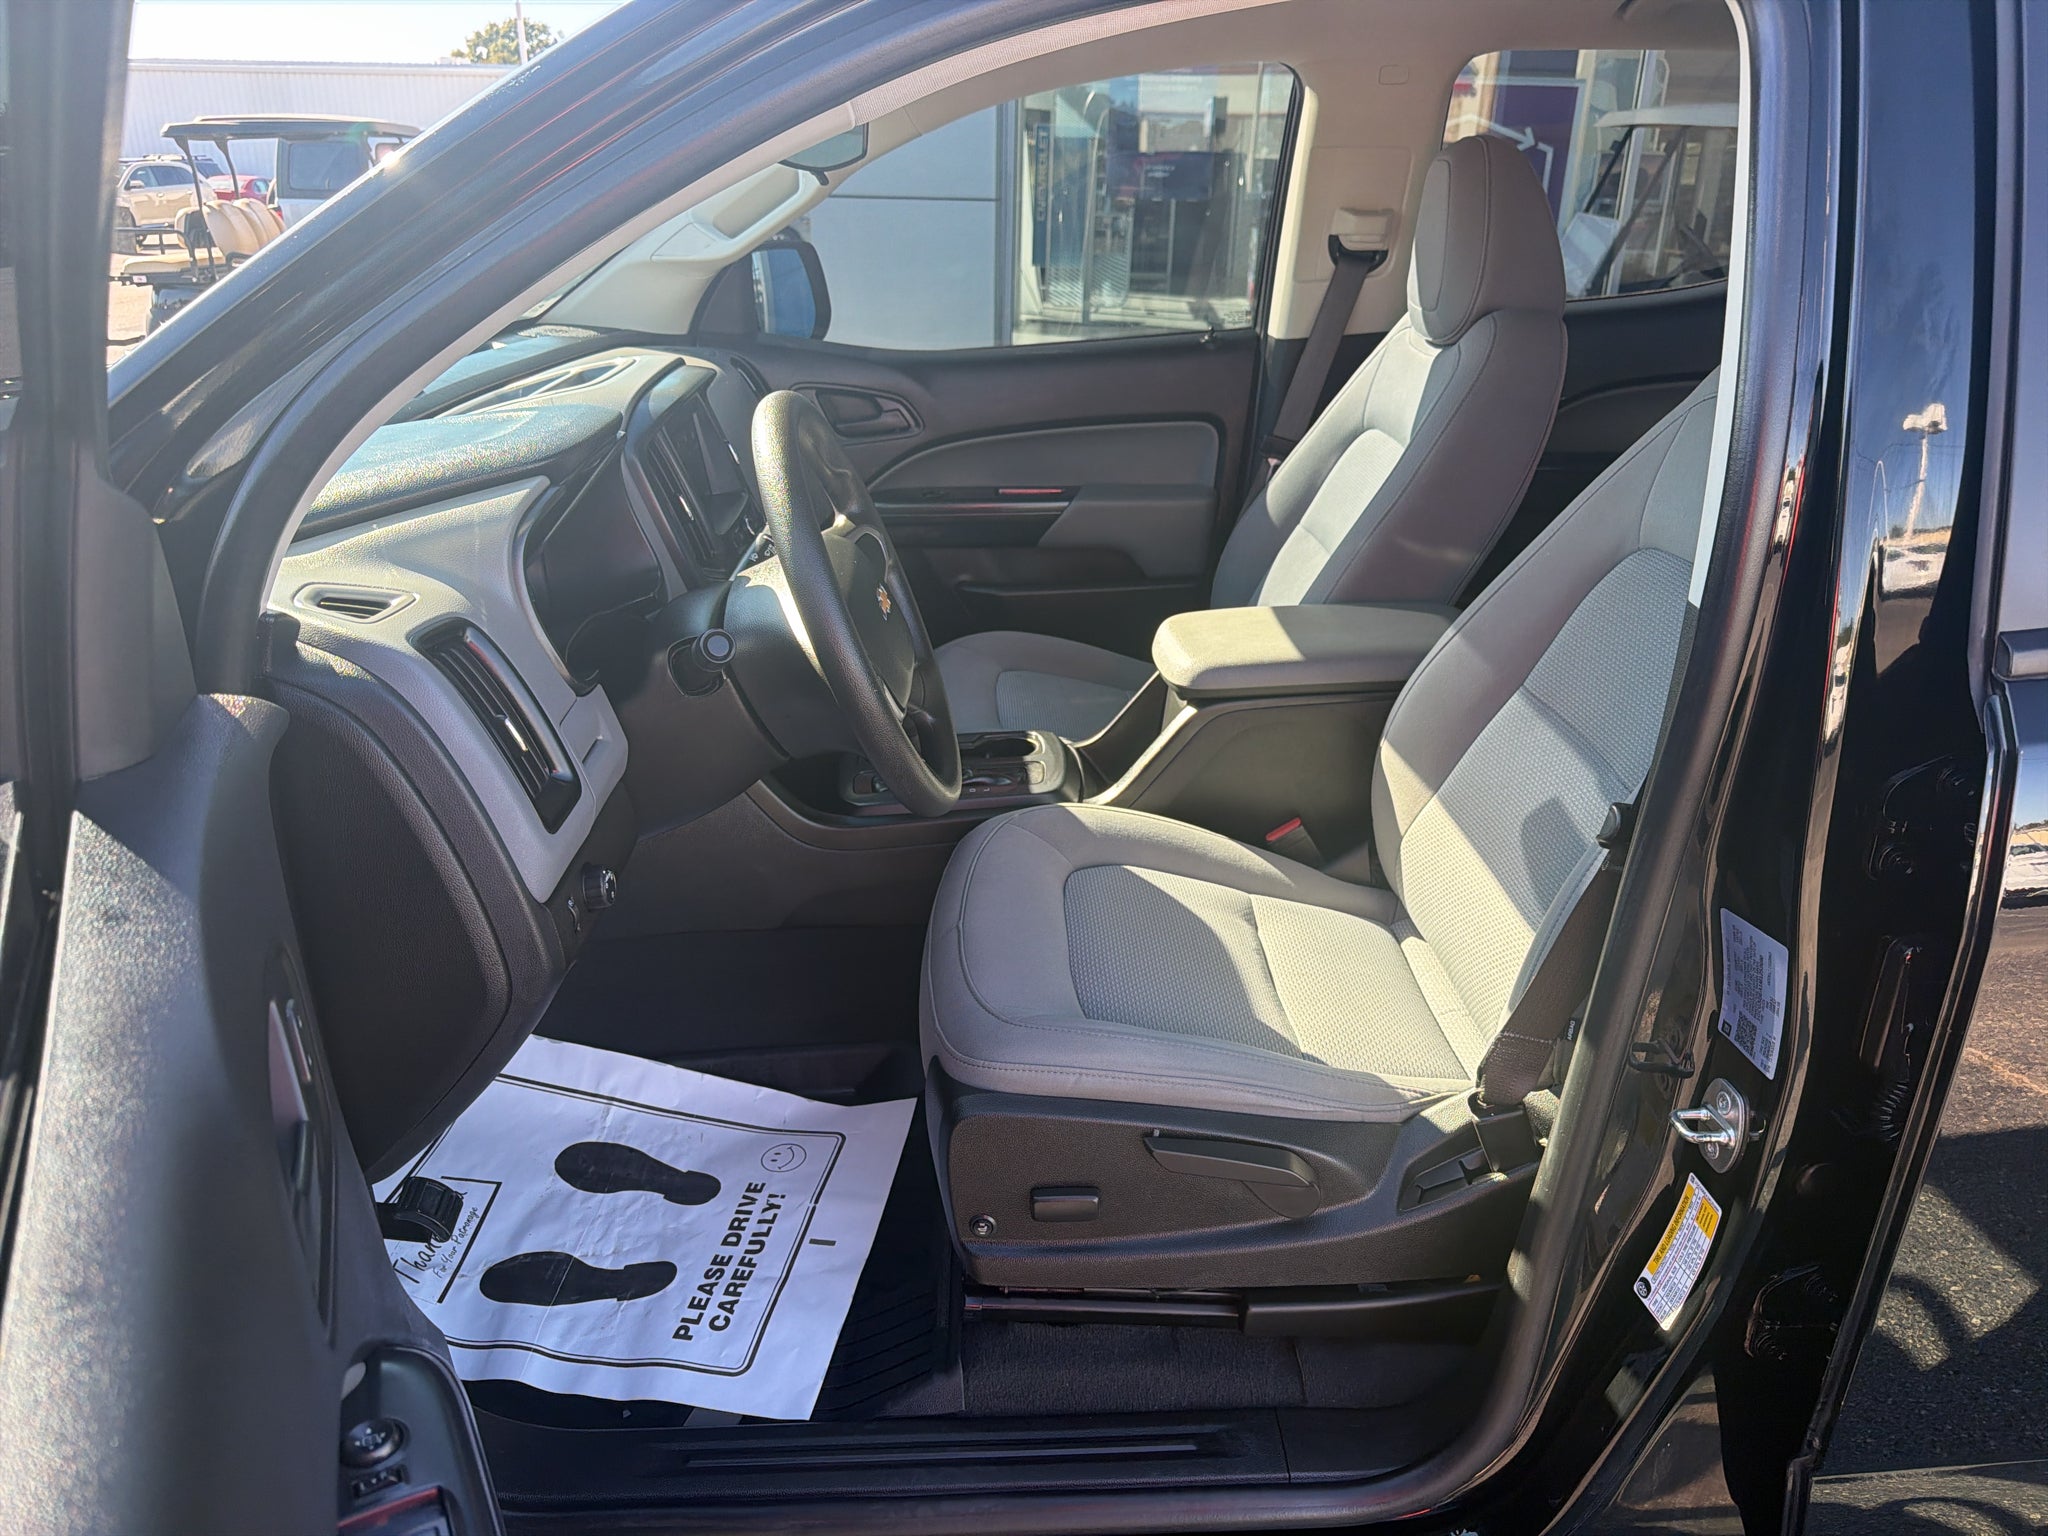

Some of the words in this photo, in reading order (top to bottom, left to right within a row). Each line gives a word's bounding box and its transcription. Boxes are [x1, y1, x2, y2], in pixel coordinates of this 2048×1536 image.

[1036, 129, 1049, 222] CHEVROLET
[671, 1253, 734, 1341] PLEASE
[720, 1182, 767, 1247] DRIVE
[708, 1193, 787, 1332] CAREFULLY!
[1652, 1252, 1663, 1265] TIRE
[1659, 1242, 1667, 1255] AND
[1664, 1223, 1677, 1247] LOADING
[1673, 1195, 1691, 1227] INFORMATION
